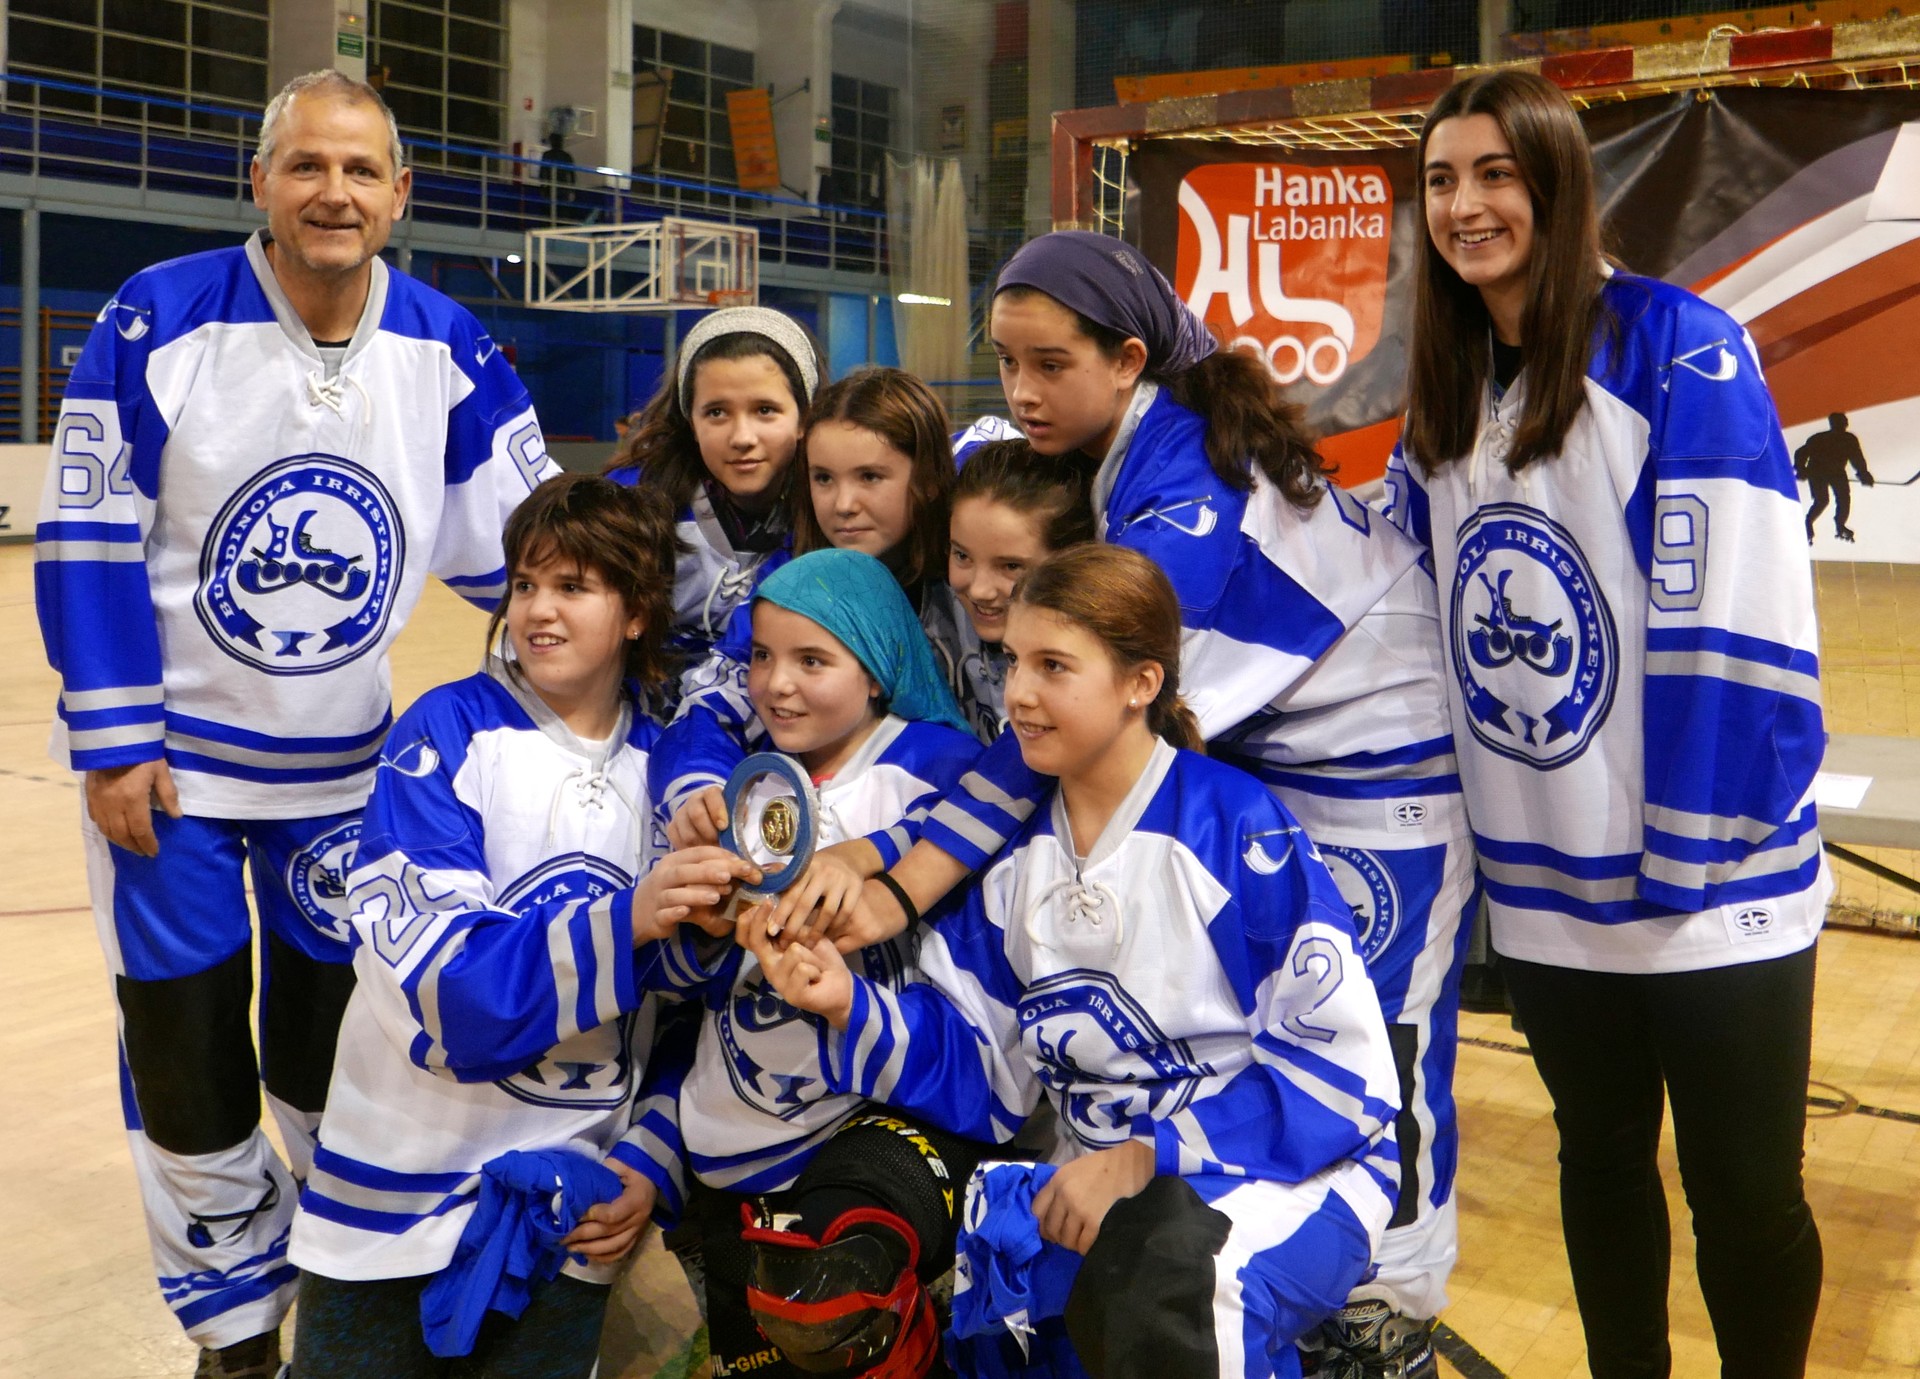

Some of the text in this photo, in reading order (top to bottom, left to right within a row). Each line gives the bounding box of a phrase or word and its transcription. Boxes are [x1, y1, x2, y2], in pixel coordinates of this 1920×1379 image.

[1253, 207, 1385, 242] Labanka
[1254, 167, 1387, 207] Hanka
[312, 474, 391, 627] IRRISTAKETA
[1650, 493, 1709, 612] 9
[1280, 936, 1343, 1044] 2
